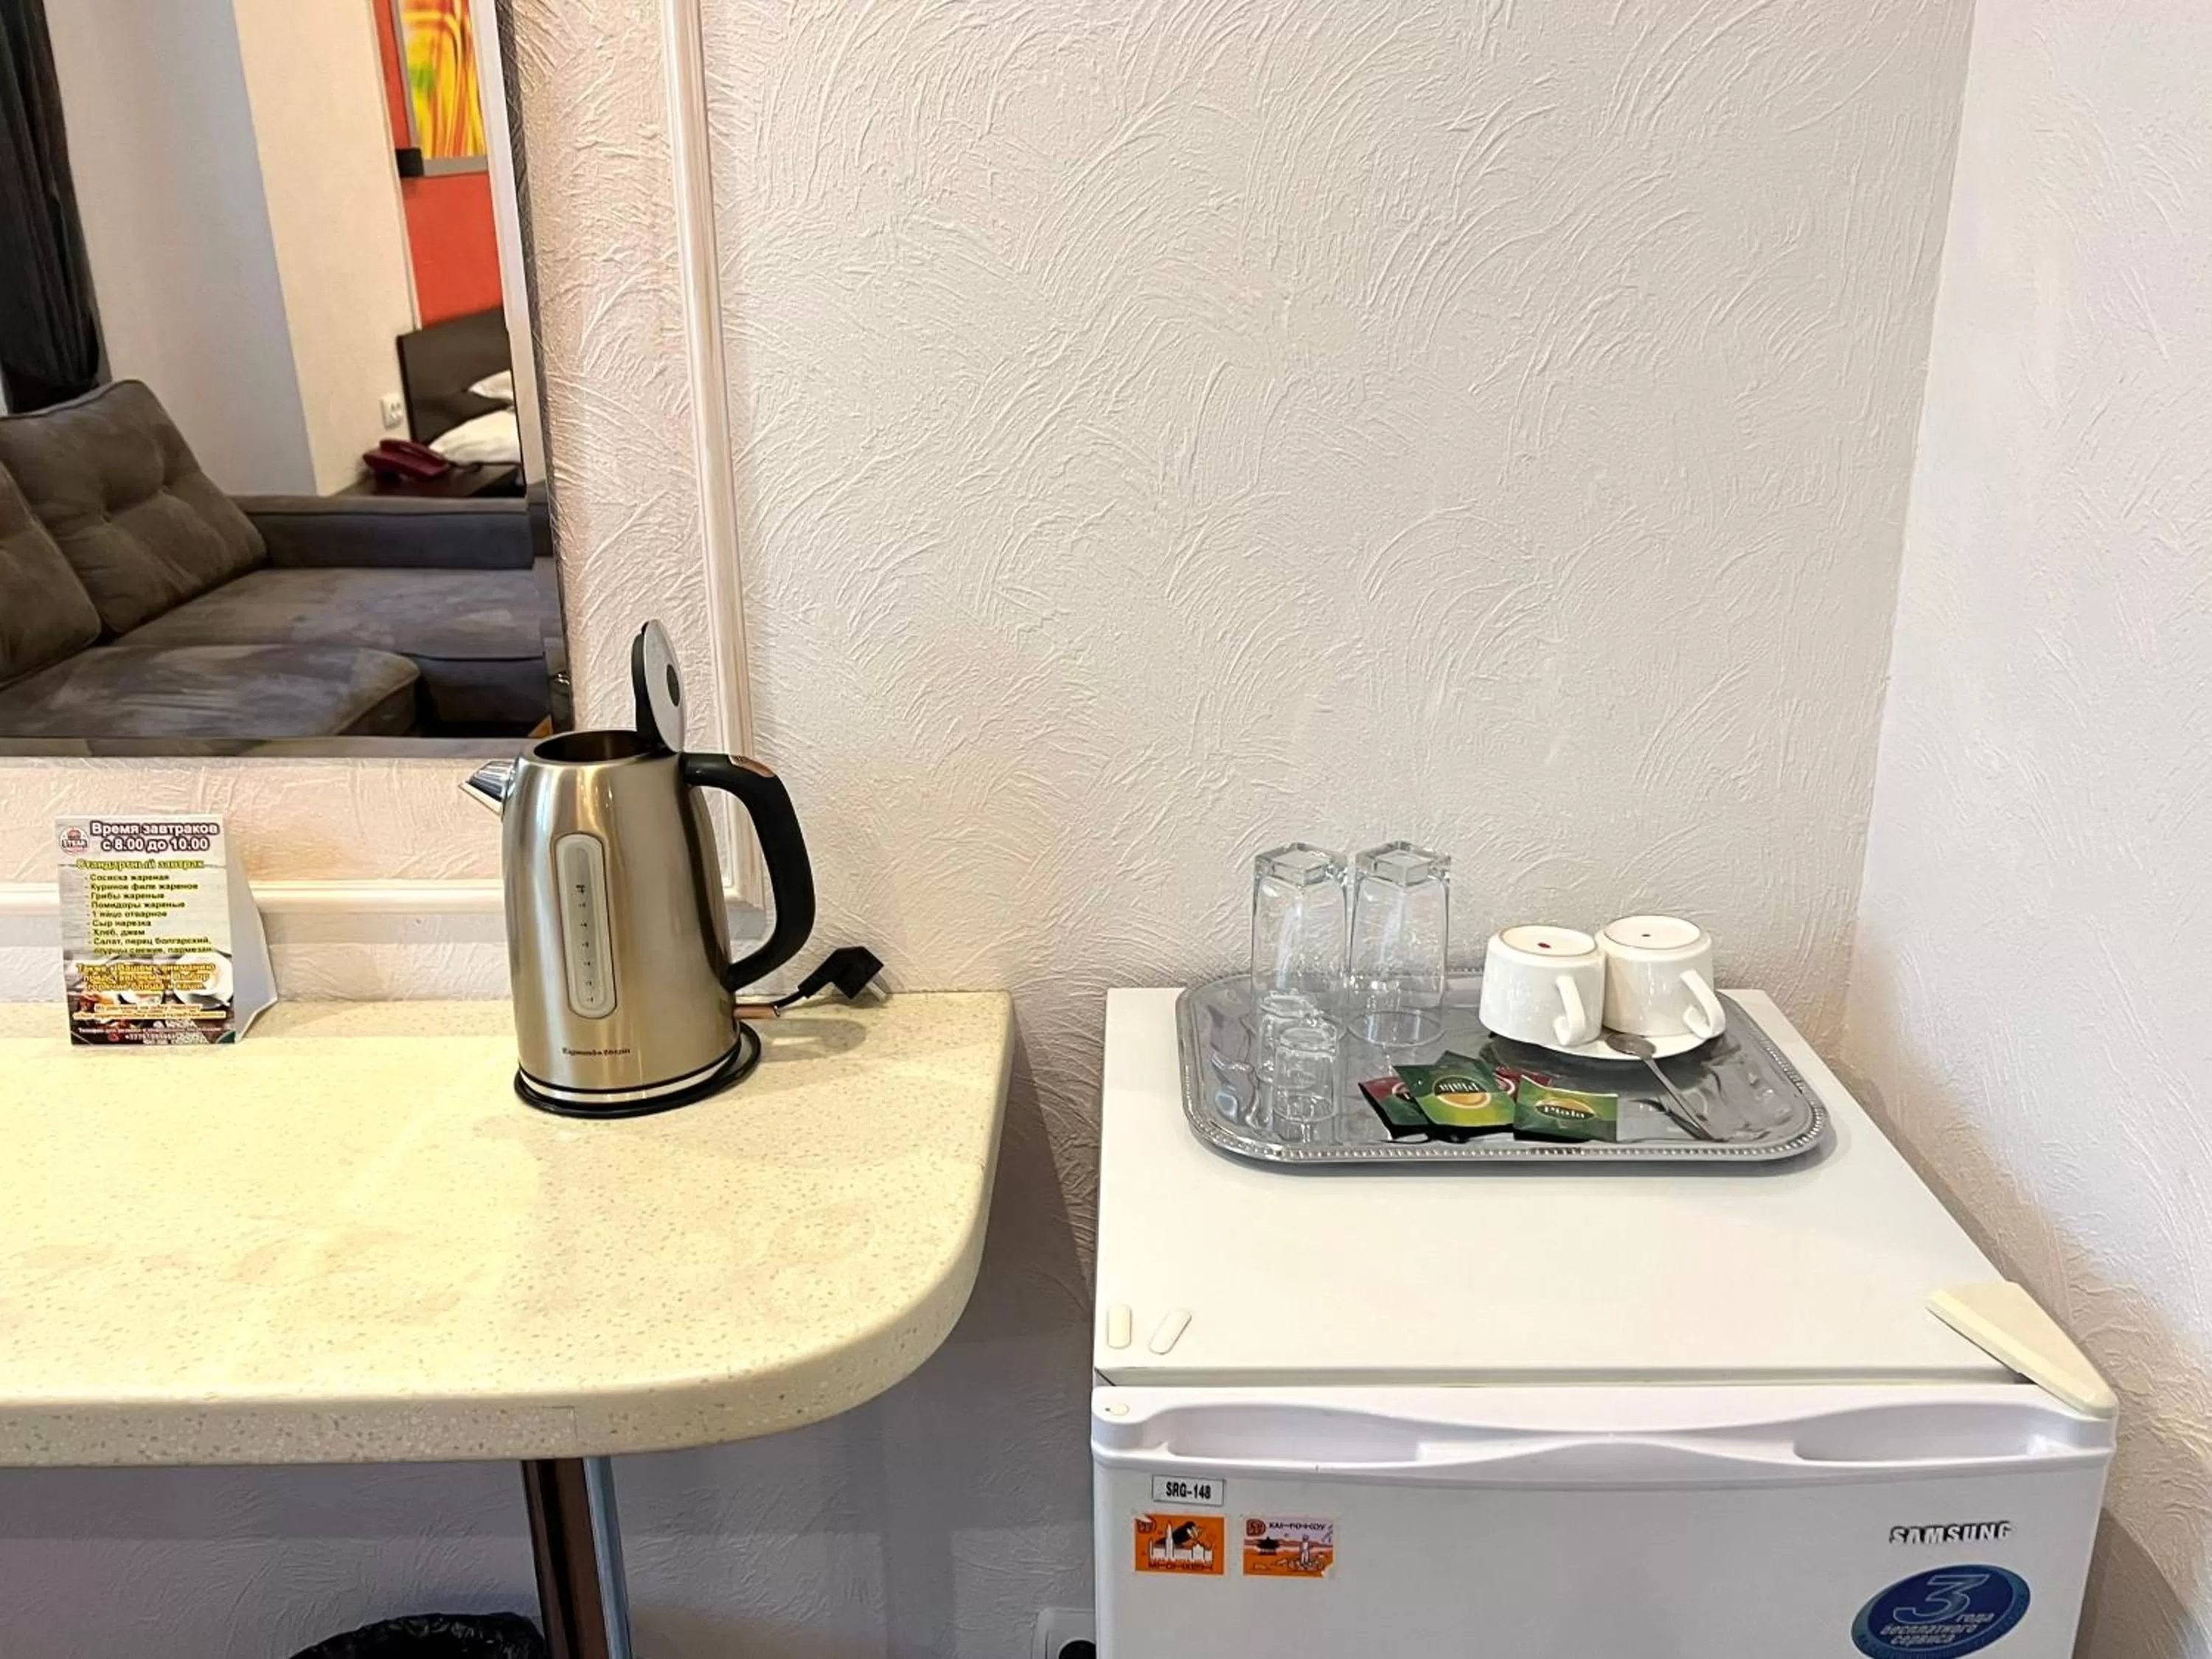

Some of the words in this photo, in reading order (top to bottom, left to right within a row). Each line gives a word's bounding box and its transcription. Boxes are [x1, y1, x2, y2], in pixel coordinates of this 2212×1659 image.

[90, 821, 140, 837] Время
[141, 823, 220, 838] завтраков
[102, 839, 112, 851] с
[114, 837, 144, 851] 8.00
[147, 839, 167, 852] до
[170, 838, 209, 851] 10.00
[91, 901, 141, 909] Помидоры
[1166, 1481, 1211, 1499] SRG-148
[1889, 1520, 2014, 1544] SAMSUNG
[1893, 1573, 1990, 1624] 3
